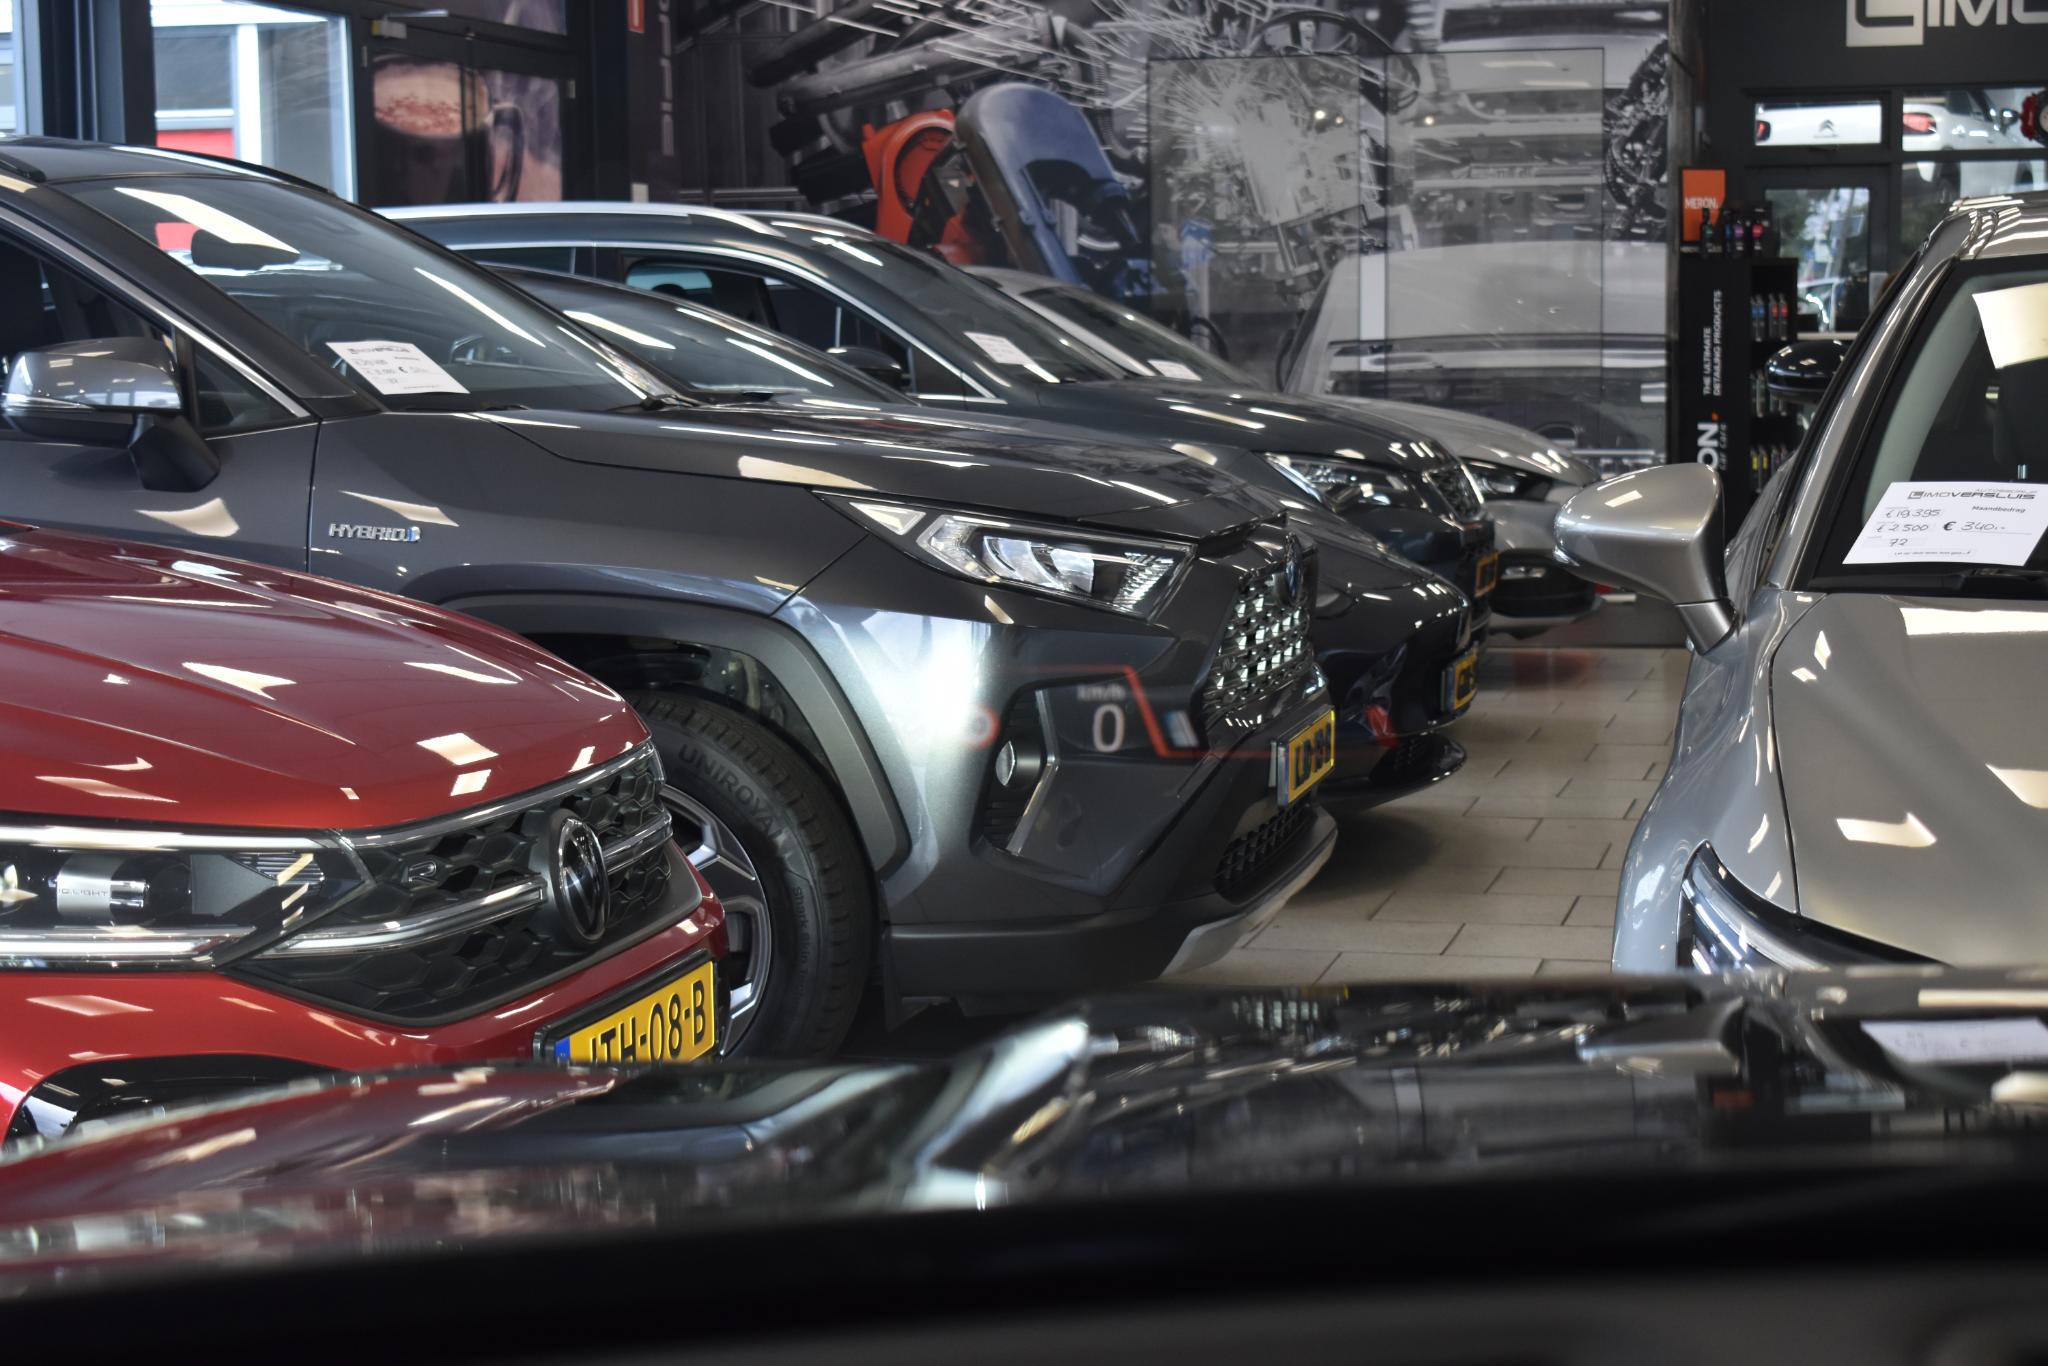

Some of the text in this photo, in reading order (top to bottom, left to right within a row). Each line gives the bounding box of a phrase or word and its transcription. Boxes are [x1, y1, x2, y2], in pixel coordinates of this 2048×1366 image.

[1703, 327, 1711, 396] THE ULTIMATE
[1713, 290, 1722, 397] DETAILING PRODUCTS
[328, 523, 406, 541] HYBRID
[1943, 521, 1957, 531] €
[1092, 703, 1125, 752] 0
